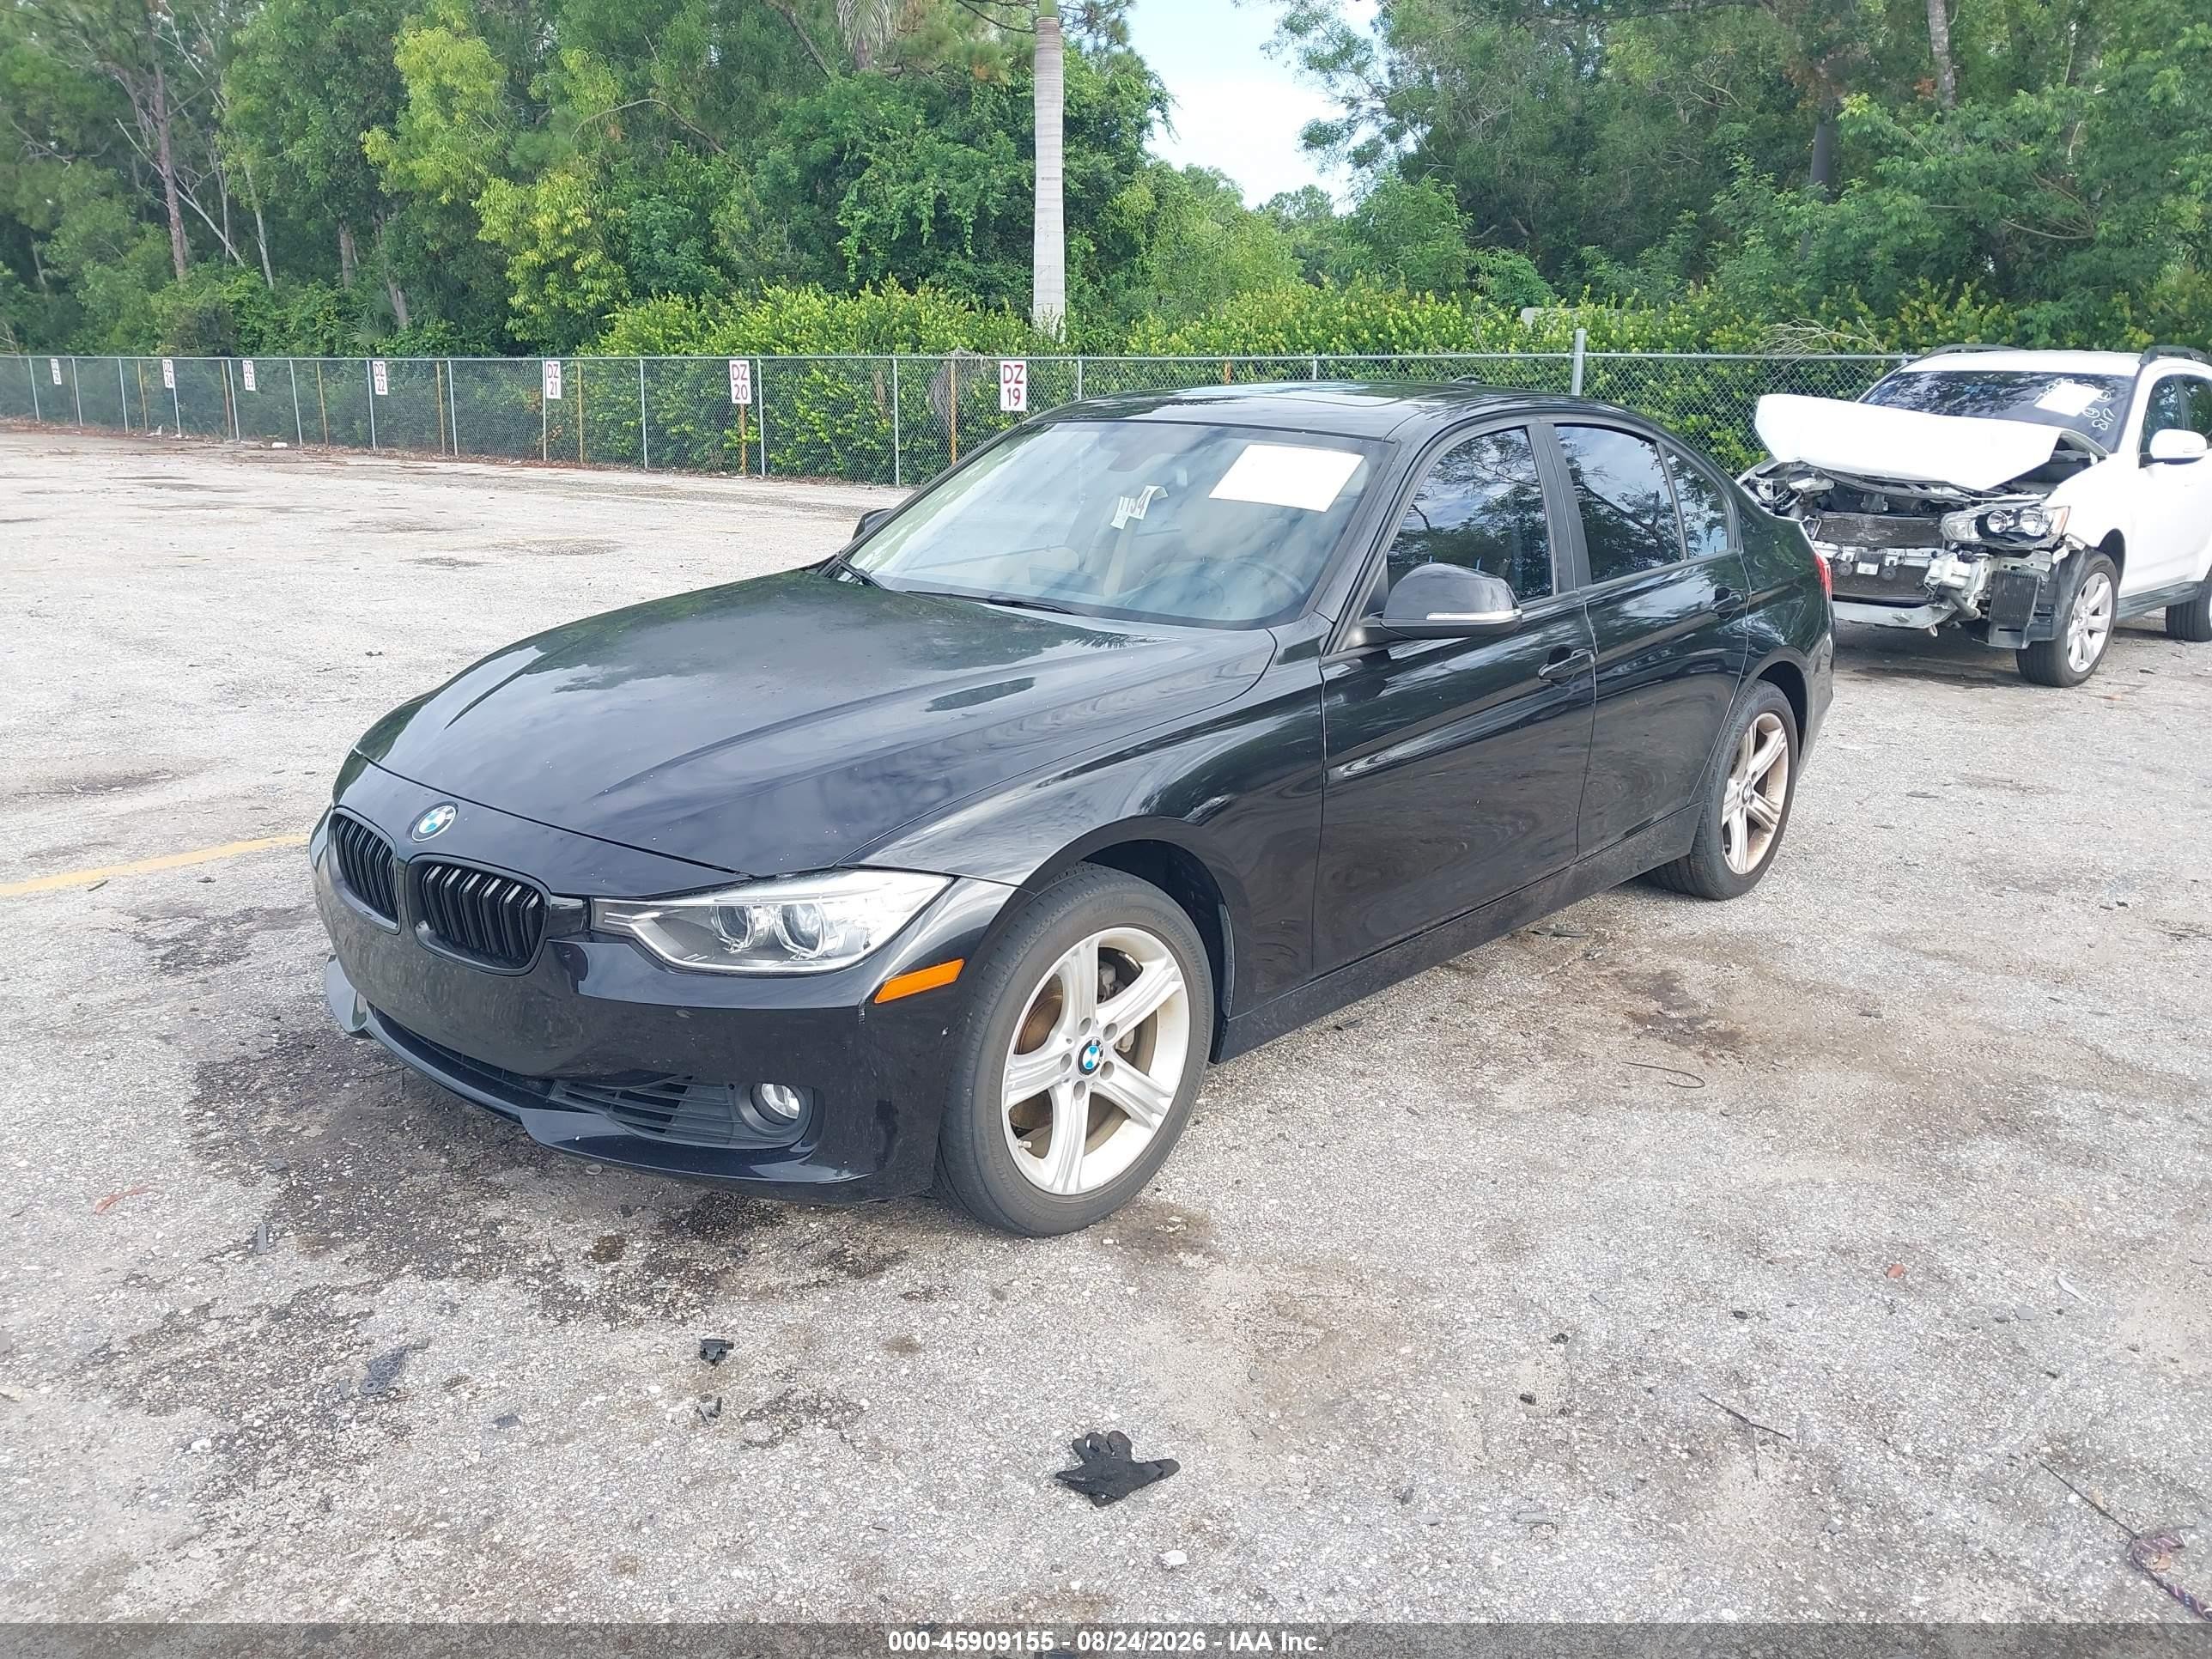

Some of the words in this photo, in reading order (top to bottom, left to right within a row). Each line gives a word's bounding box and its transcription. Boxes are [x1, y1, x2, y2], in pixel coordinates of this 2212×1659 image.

[374, 363, 385, 377] DZ
[547, 363, 559, 379] DZ
[732, 364, 748, 380] DZ
[1003, 364, 1024, 384] DZ
[377, 379, 386, 392] 22
[550, 380, 557, 395] 21
[734, 383, 748, 400] 20
[1006, 387, 1021, 407] 19
